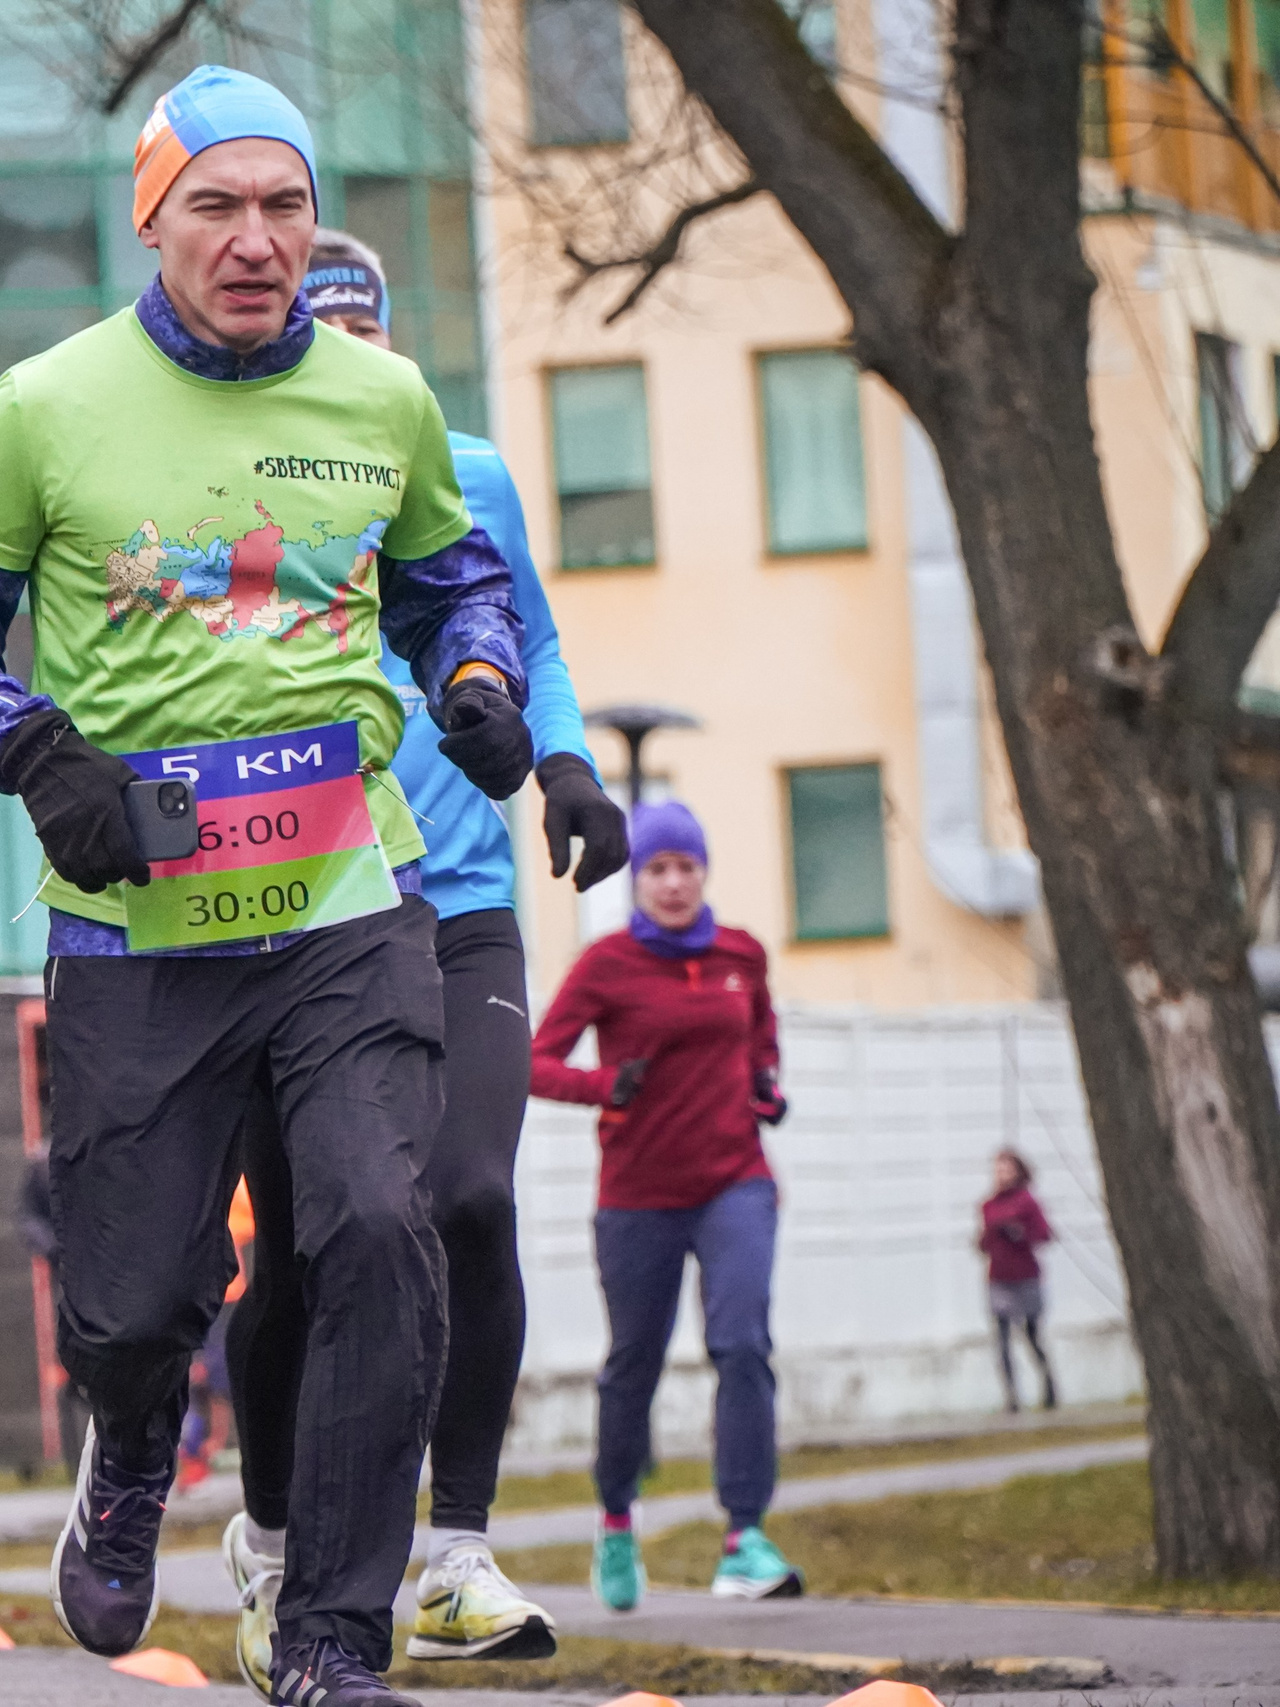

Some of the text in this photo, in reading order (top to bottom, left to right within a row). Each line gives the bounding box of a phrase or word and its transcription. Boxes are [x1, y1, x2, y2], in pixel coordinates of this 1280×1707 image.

[253, 455, 401, 491] #5ВЁРСТТУРИСТ
[161, 754, 200, 784] 5
[185, 880, 309, 927] 30:00
